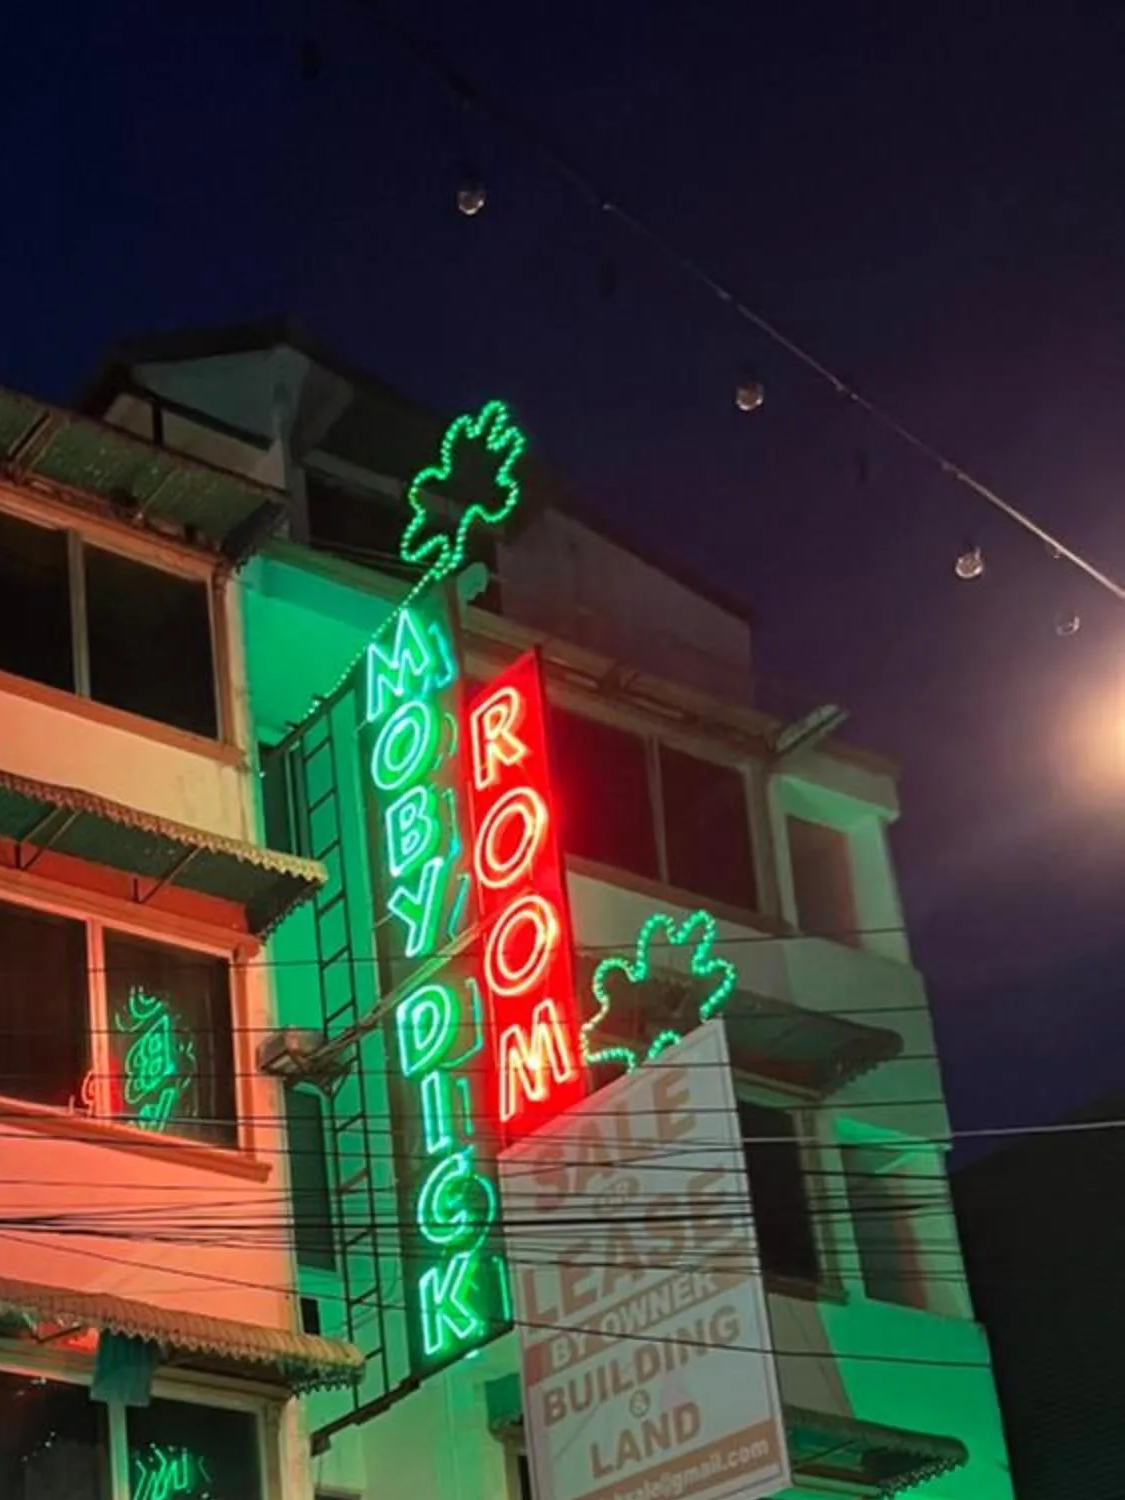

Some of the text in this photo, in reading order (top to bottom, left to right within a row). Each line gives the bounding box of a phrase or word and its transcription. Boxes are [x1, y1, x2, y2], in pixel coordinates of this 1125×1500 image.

[471, 686, 572, 1123] ROOM
[365, 608, 481, 1357] MOBY DICK
[528, 1067, 698, 1215] SALE
[521, 1162, 737, 1322] LEASE
[541, 1304, 742, 1427] BUILDING
[550, 1266, 718, 1371] BY OWNER
[590, 1401, 702, 1481] LAND
